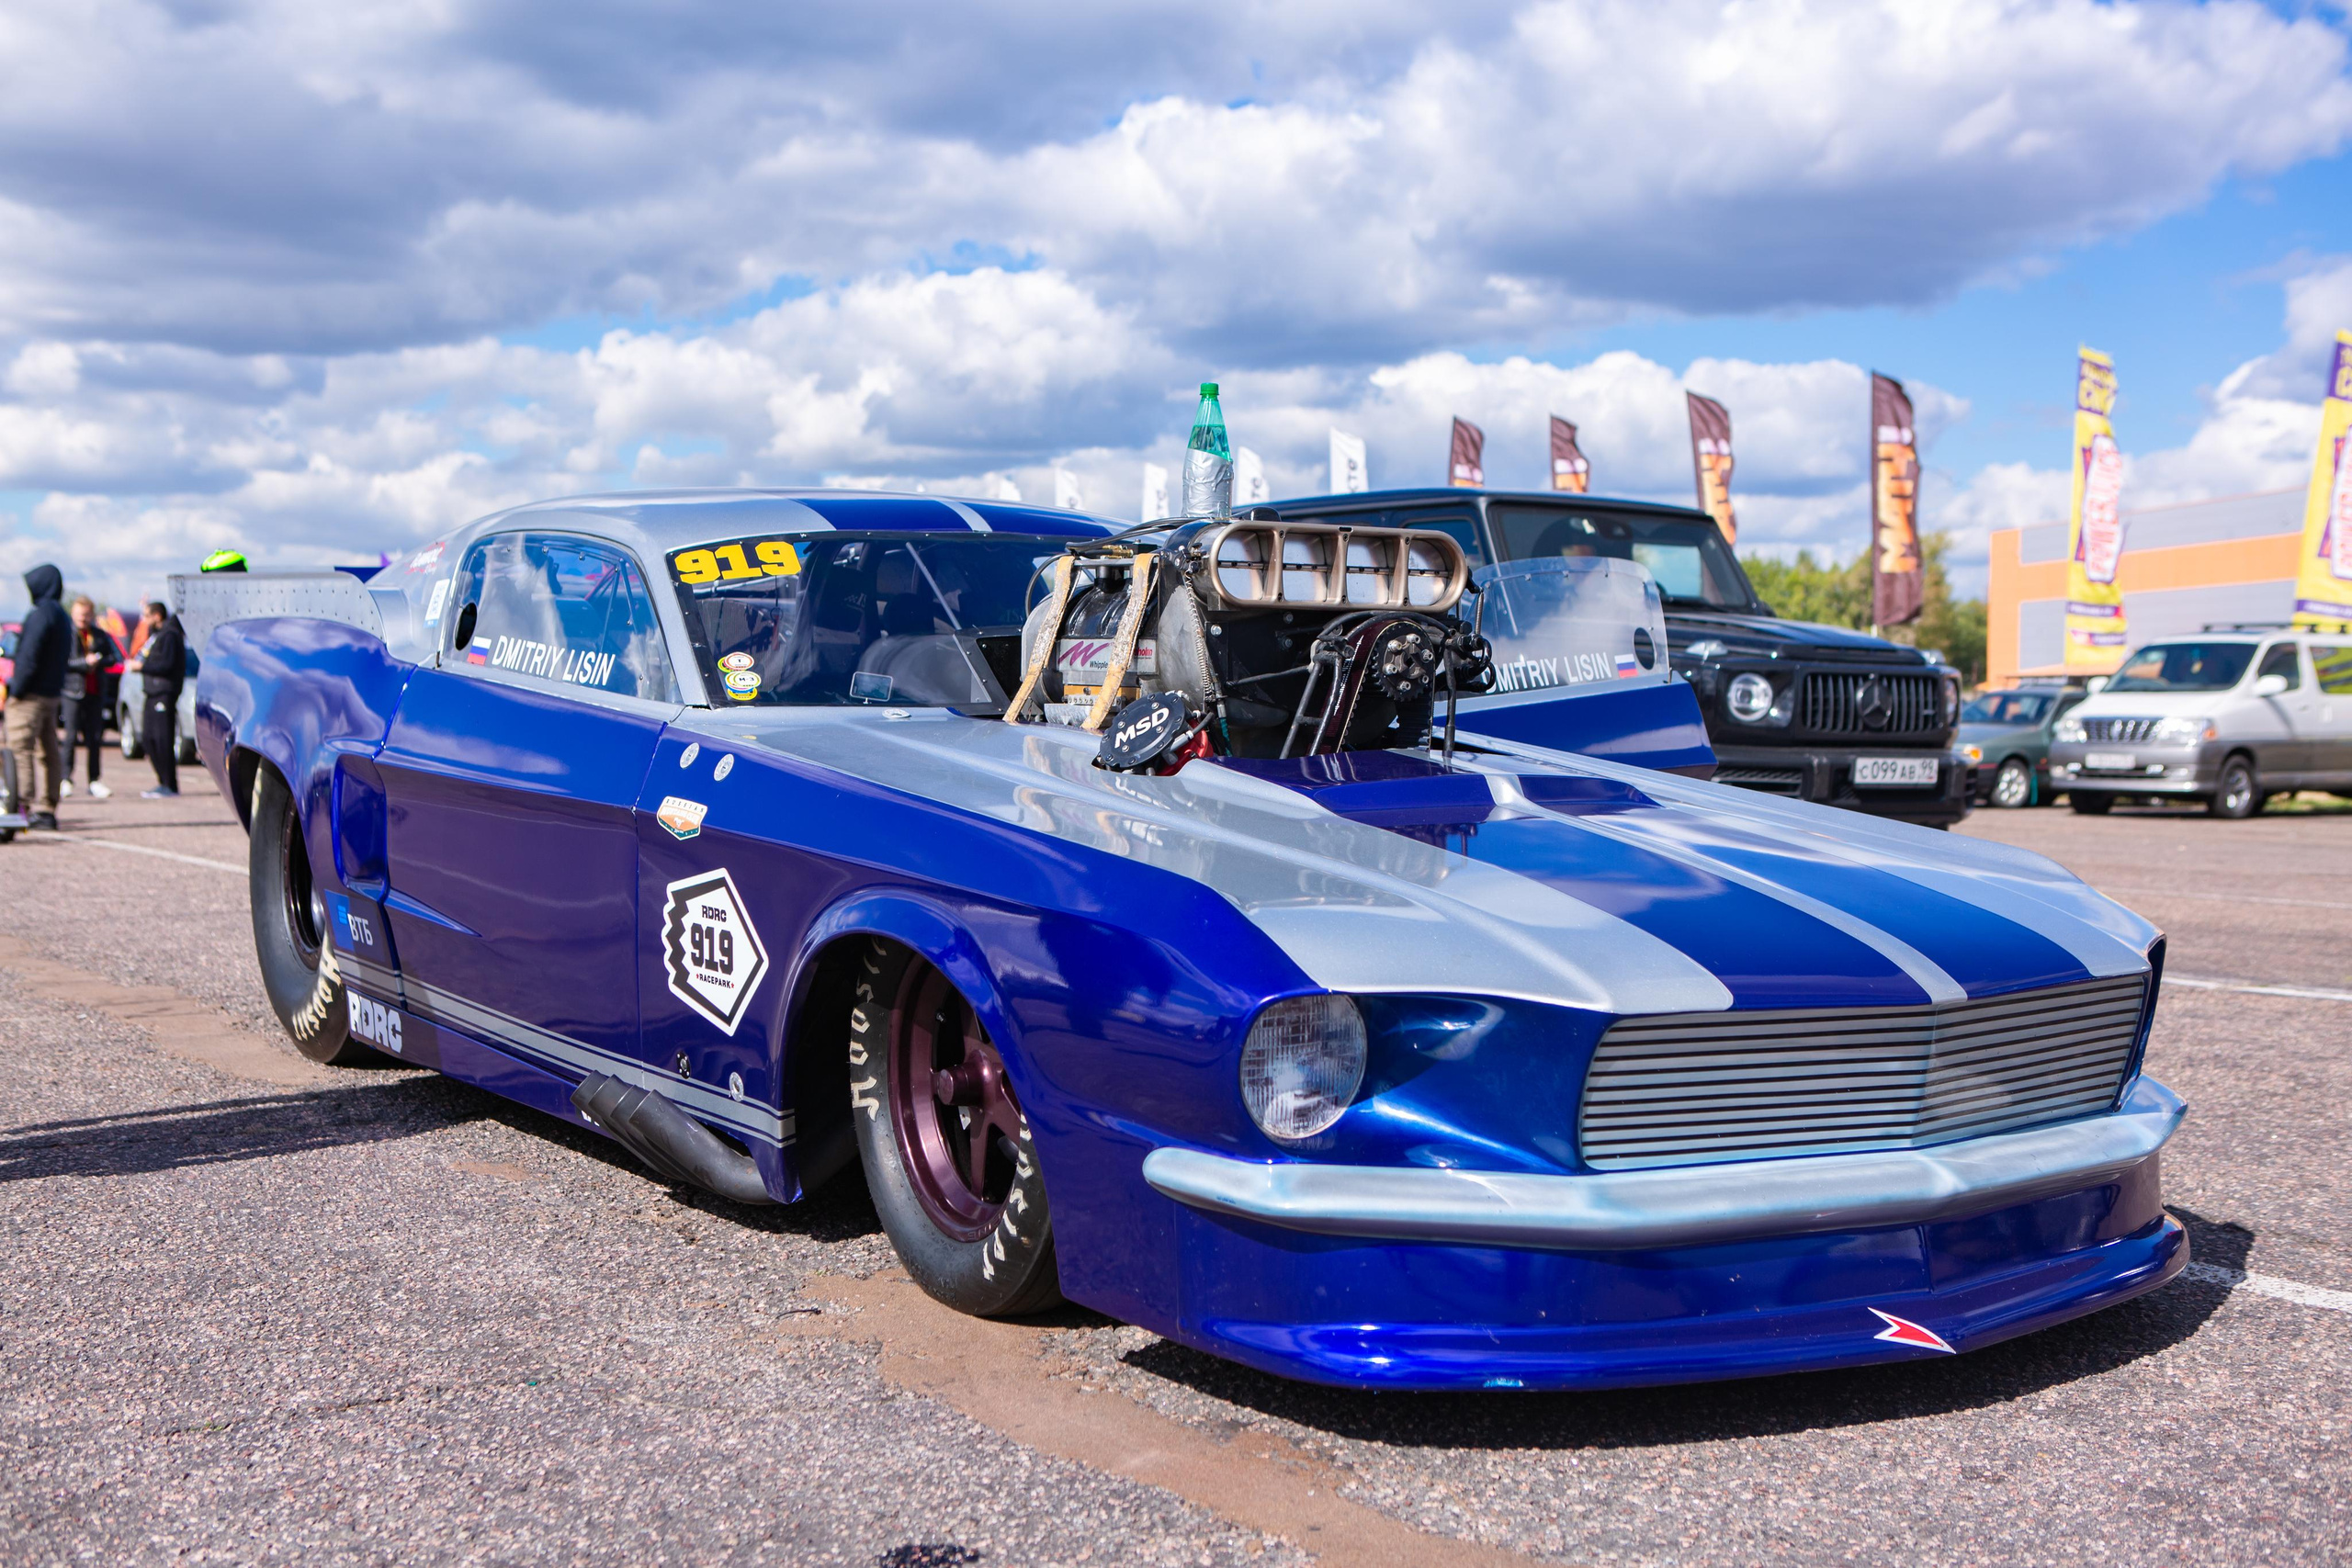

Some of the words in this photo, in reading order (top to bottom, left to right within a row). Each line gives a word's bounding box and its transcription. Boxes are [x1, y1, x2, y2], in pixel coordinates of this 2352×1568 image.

[674, 541, 802, 585] 919
[492, 635, 565, 678] DMITRIY
[562, 649, 616, 686] LISIN
[1564, 651, 1612, 683] LISIN
[1114, 707, 1170, 749] MSD
[665, 798, 705, 813] RUSSIAN
[347, 913, 373, 946] ВТБ
[701, 905, 727, 923] RDRC
[690, 922, 734, 976] 919
[699, 974, 731, 989] RACEPARK
[346, 989, 402, 1054] RDRC
